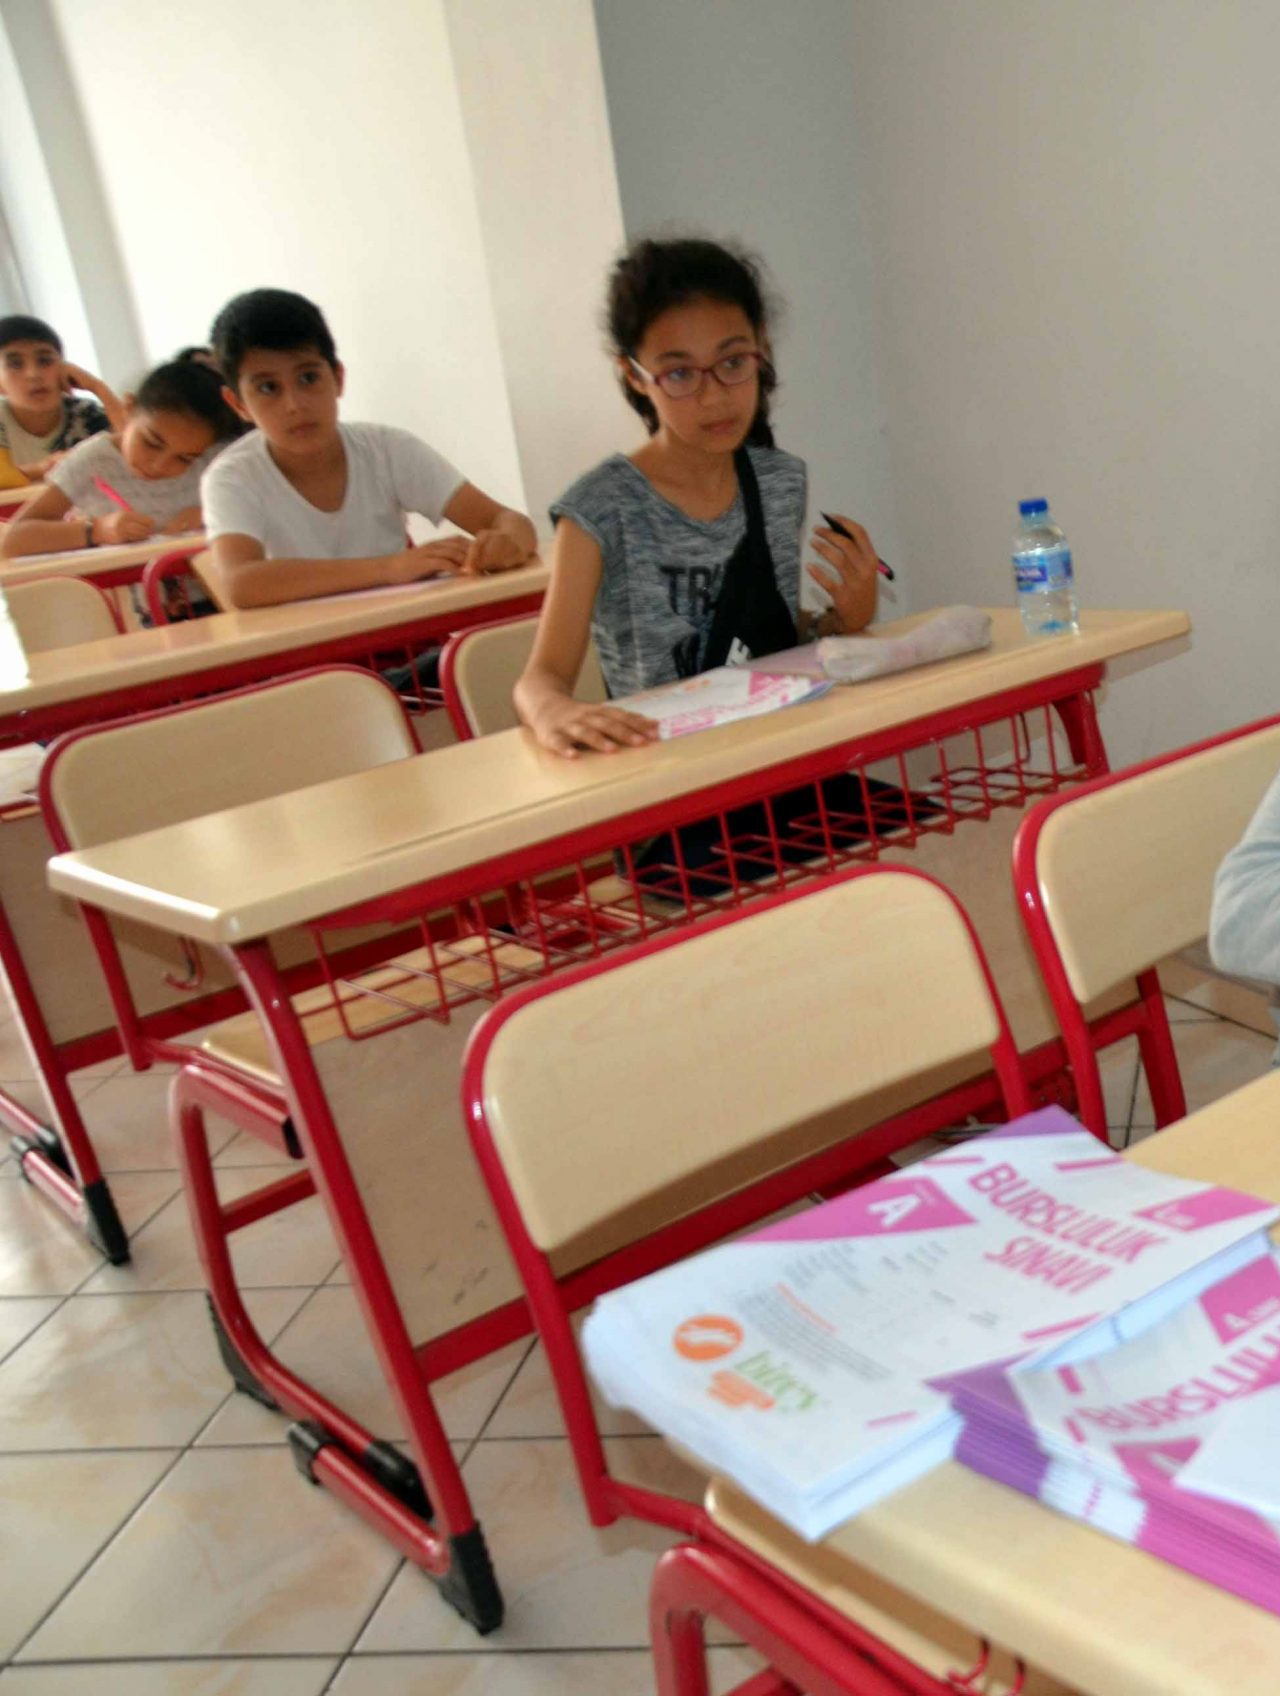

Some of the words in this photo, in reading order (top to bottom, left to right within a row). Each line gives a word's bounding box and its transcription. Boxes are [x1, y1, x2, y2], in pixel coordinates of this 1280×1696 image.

[660, 564, 722, 616] TR
[867, 1193, 918, 1227] A
[968, 1162, 1169, 1264] BURSLULUK
[984, 1235, 1113, 1296] SINAVI
